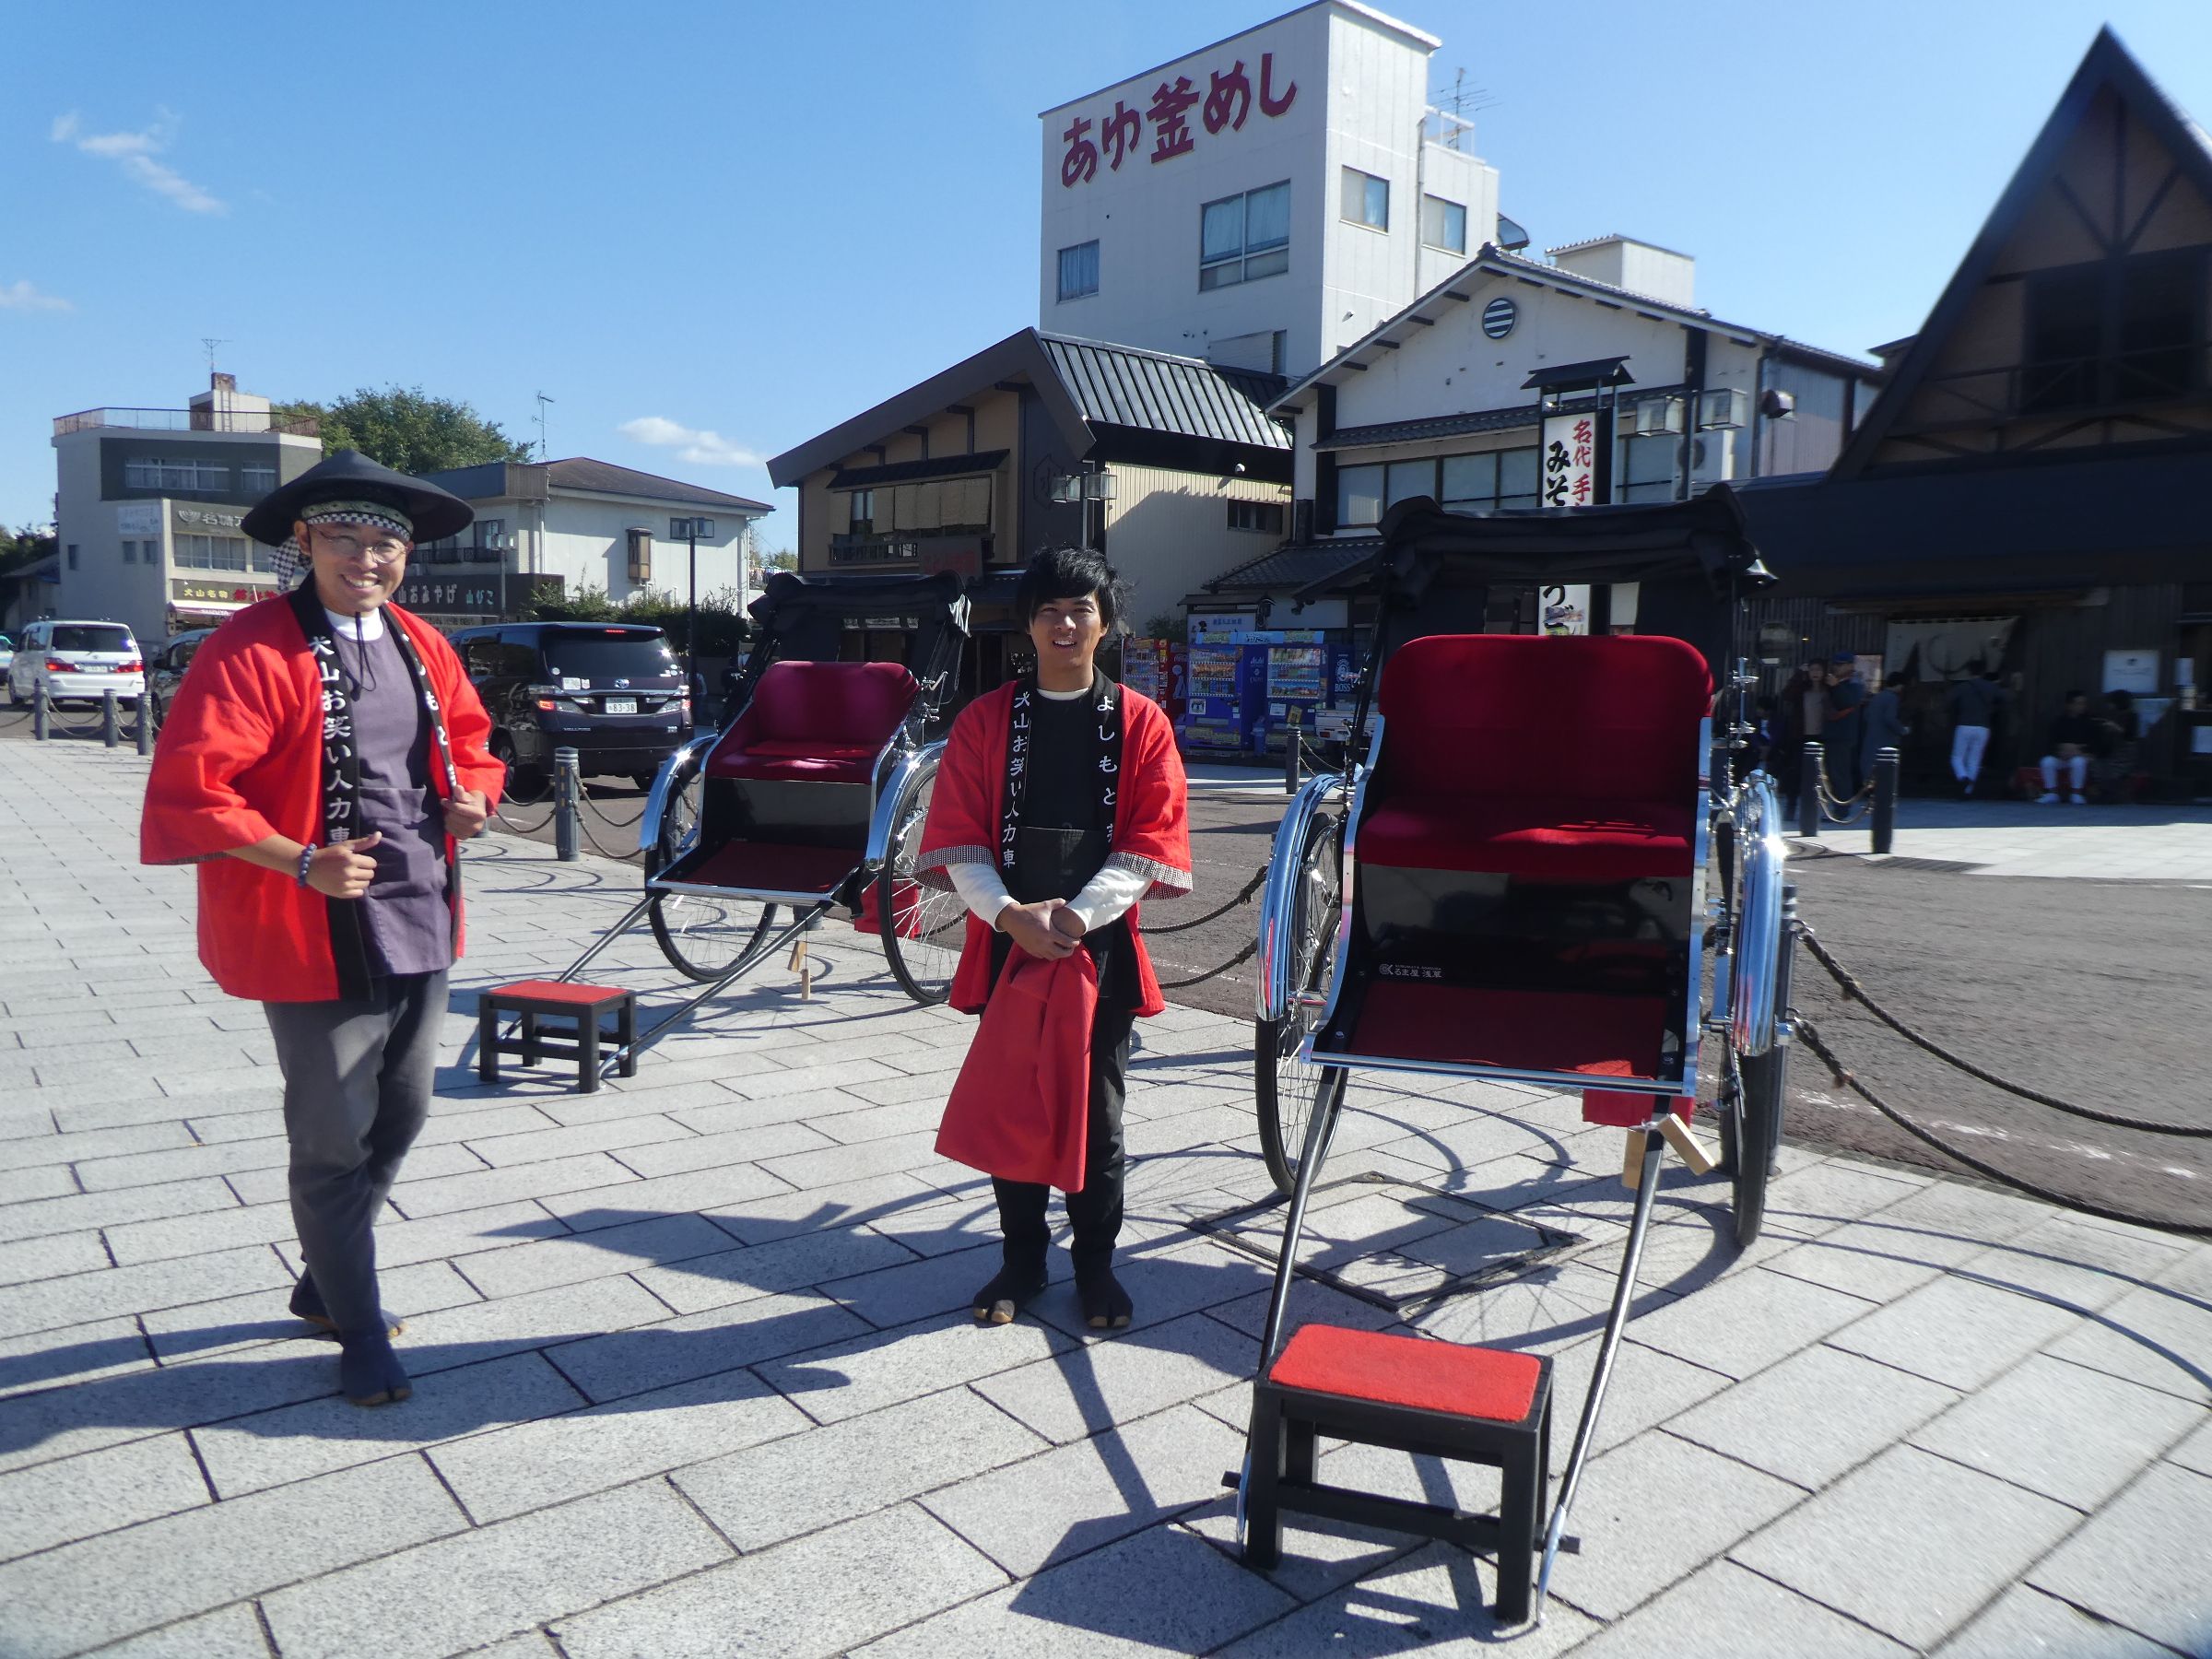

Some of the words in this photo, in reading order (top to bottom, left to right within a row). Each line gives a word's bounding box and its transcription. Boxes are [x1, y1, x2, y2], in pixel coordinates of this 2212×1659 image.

[1061, 53, 1299, 189] あゆ釜めし
[183, 588, 229, 599] 犬山名物
[390, 583, 457, 604] 山おみやげ
[465, 589, 494, 605] 山びこ
[1335, 683, 1351, 692] BOSS
[309, 635, 353, 845] 犬山お笑い人力車
[1002, 690, 1030, 868] 犬山お笑い人力車
